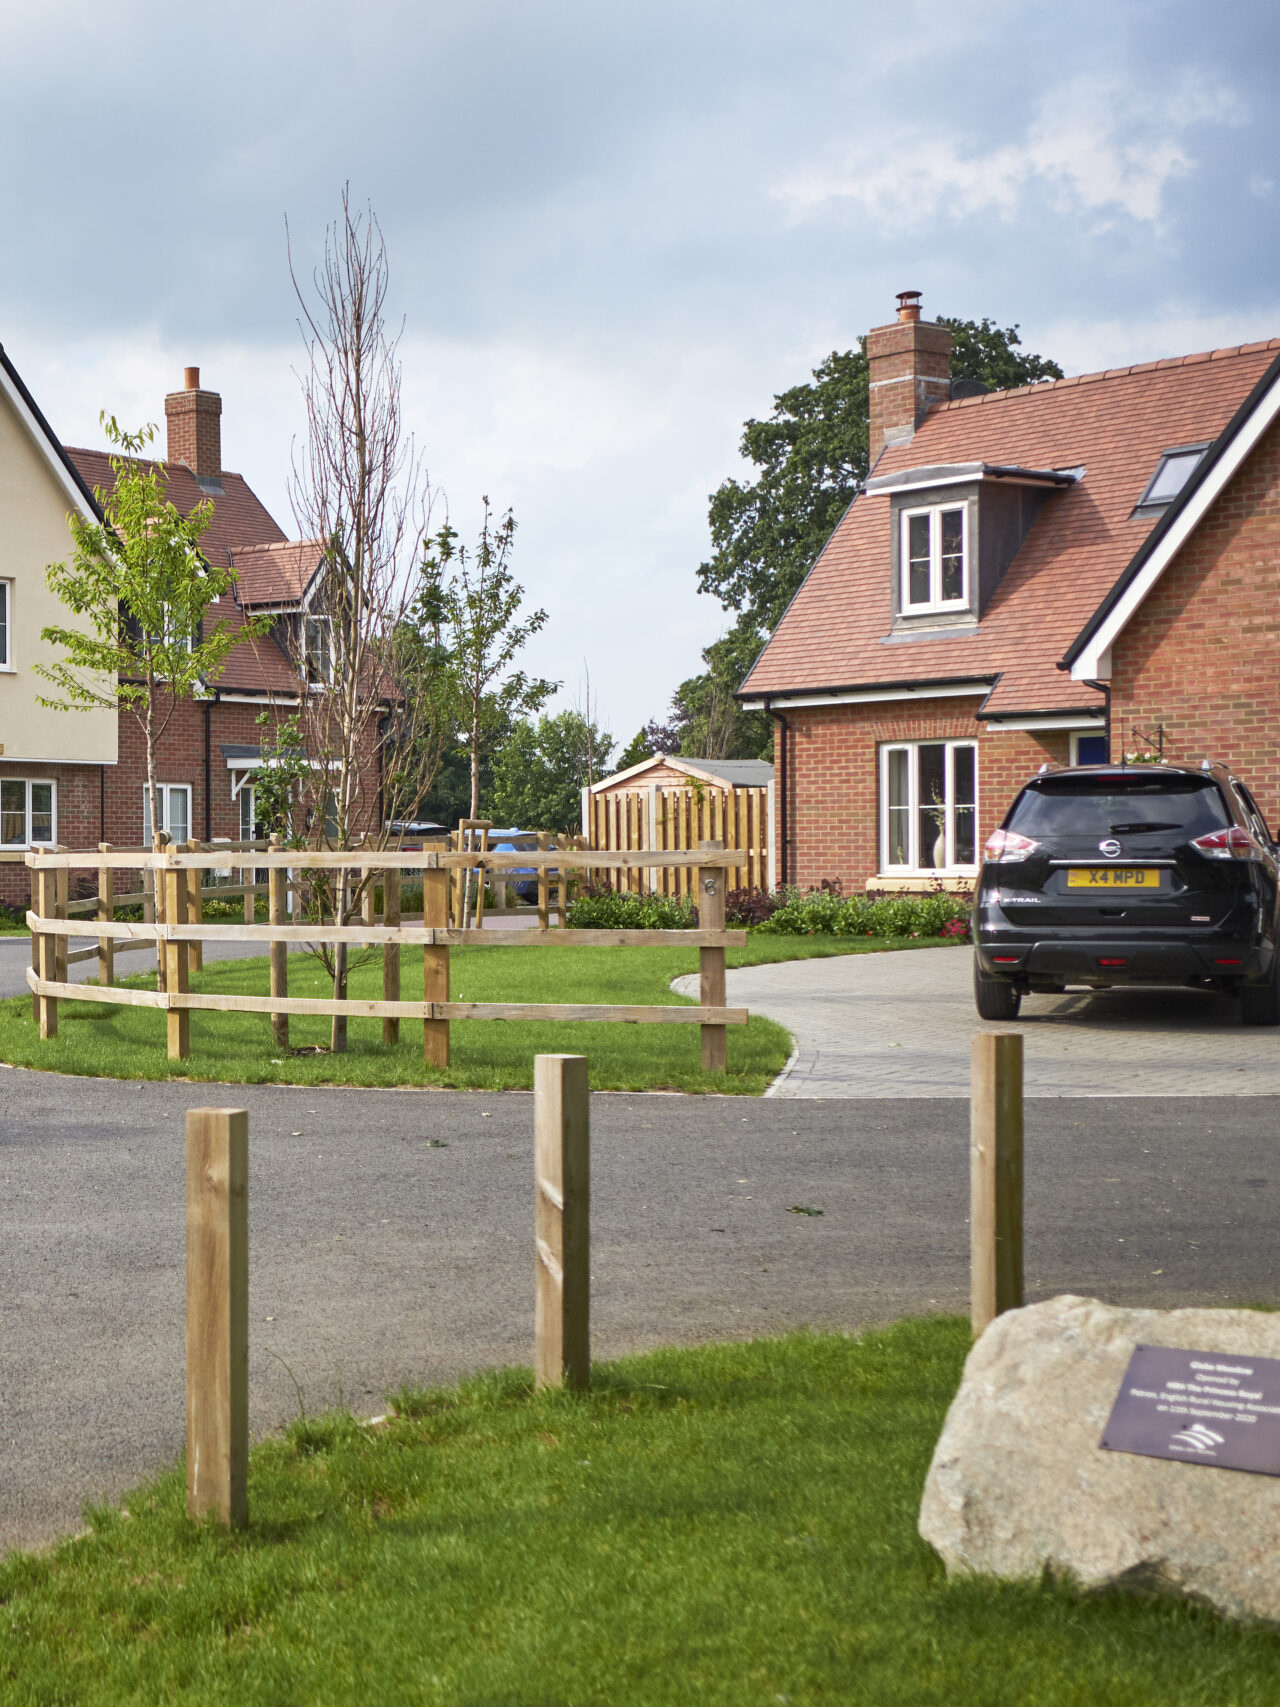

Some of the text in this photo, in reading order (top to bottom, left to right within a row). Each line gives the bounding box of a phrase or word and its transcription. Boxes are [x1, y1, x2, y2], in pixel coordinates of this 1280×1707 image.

[1089, 870, 1145, 884] X4 MPD
[704, 878, 717, 896] 6
